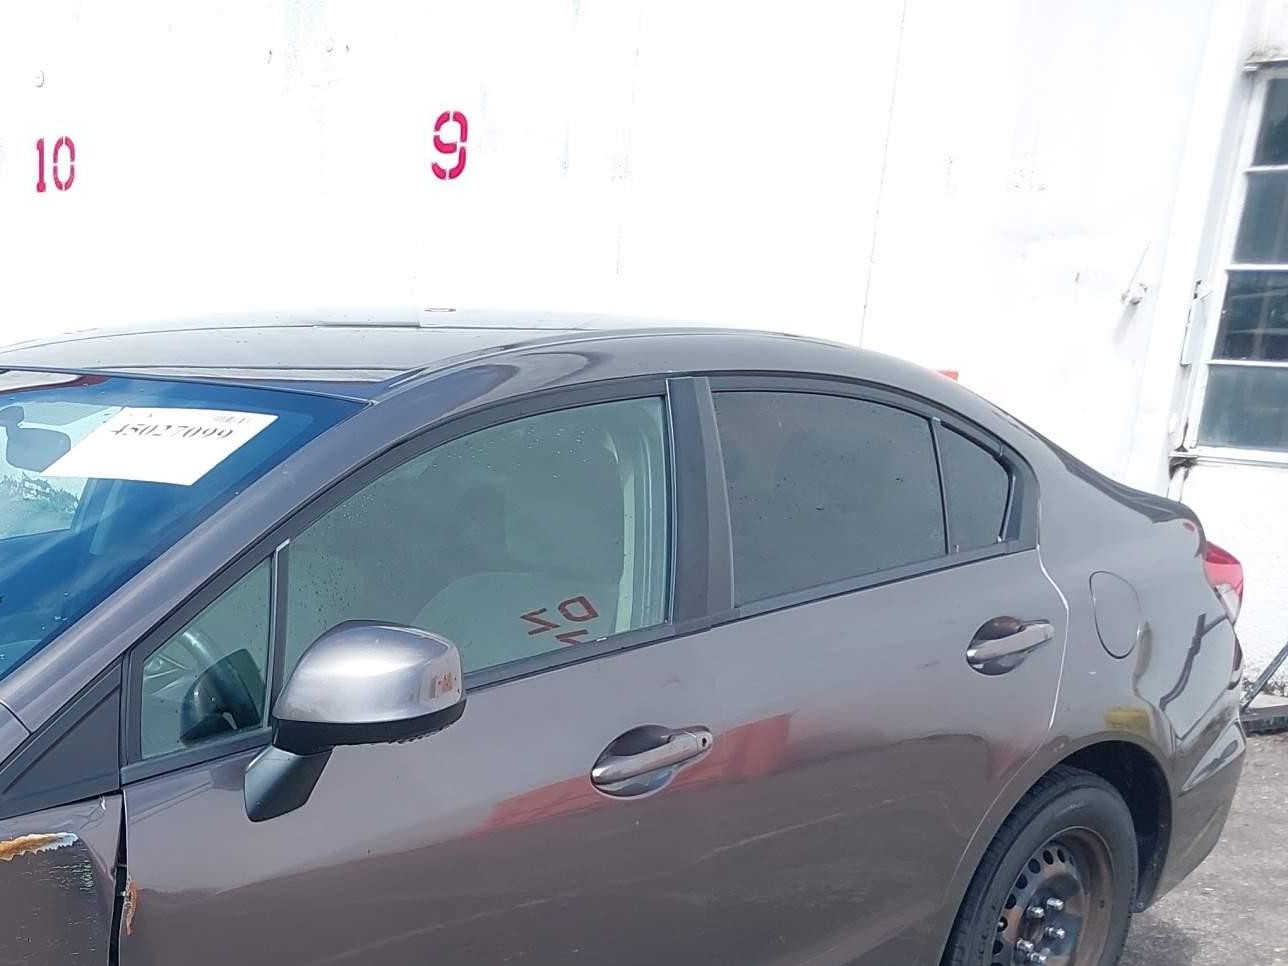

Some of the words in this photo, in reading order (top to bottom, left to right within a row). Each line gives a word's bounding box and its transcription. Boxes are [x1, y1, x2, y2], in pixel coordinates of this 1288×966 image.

[36, 136, 75, 192] 10
[431, 110, 467, 180] 9
[110, 422, 234, 440] 45027099
